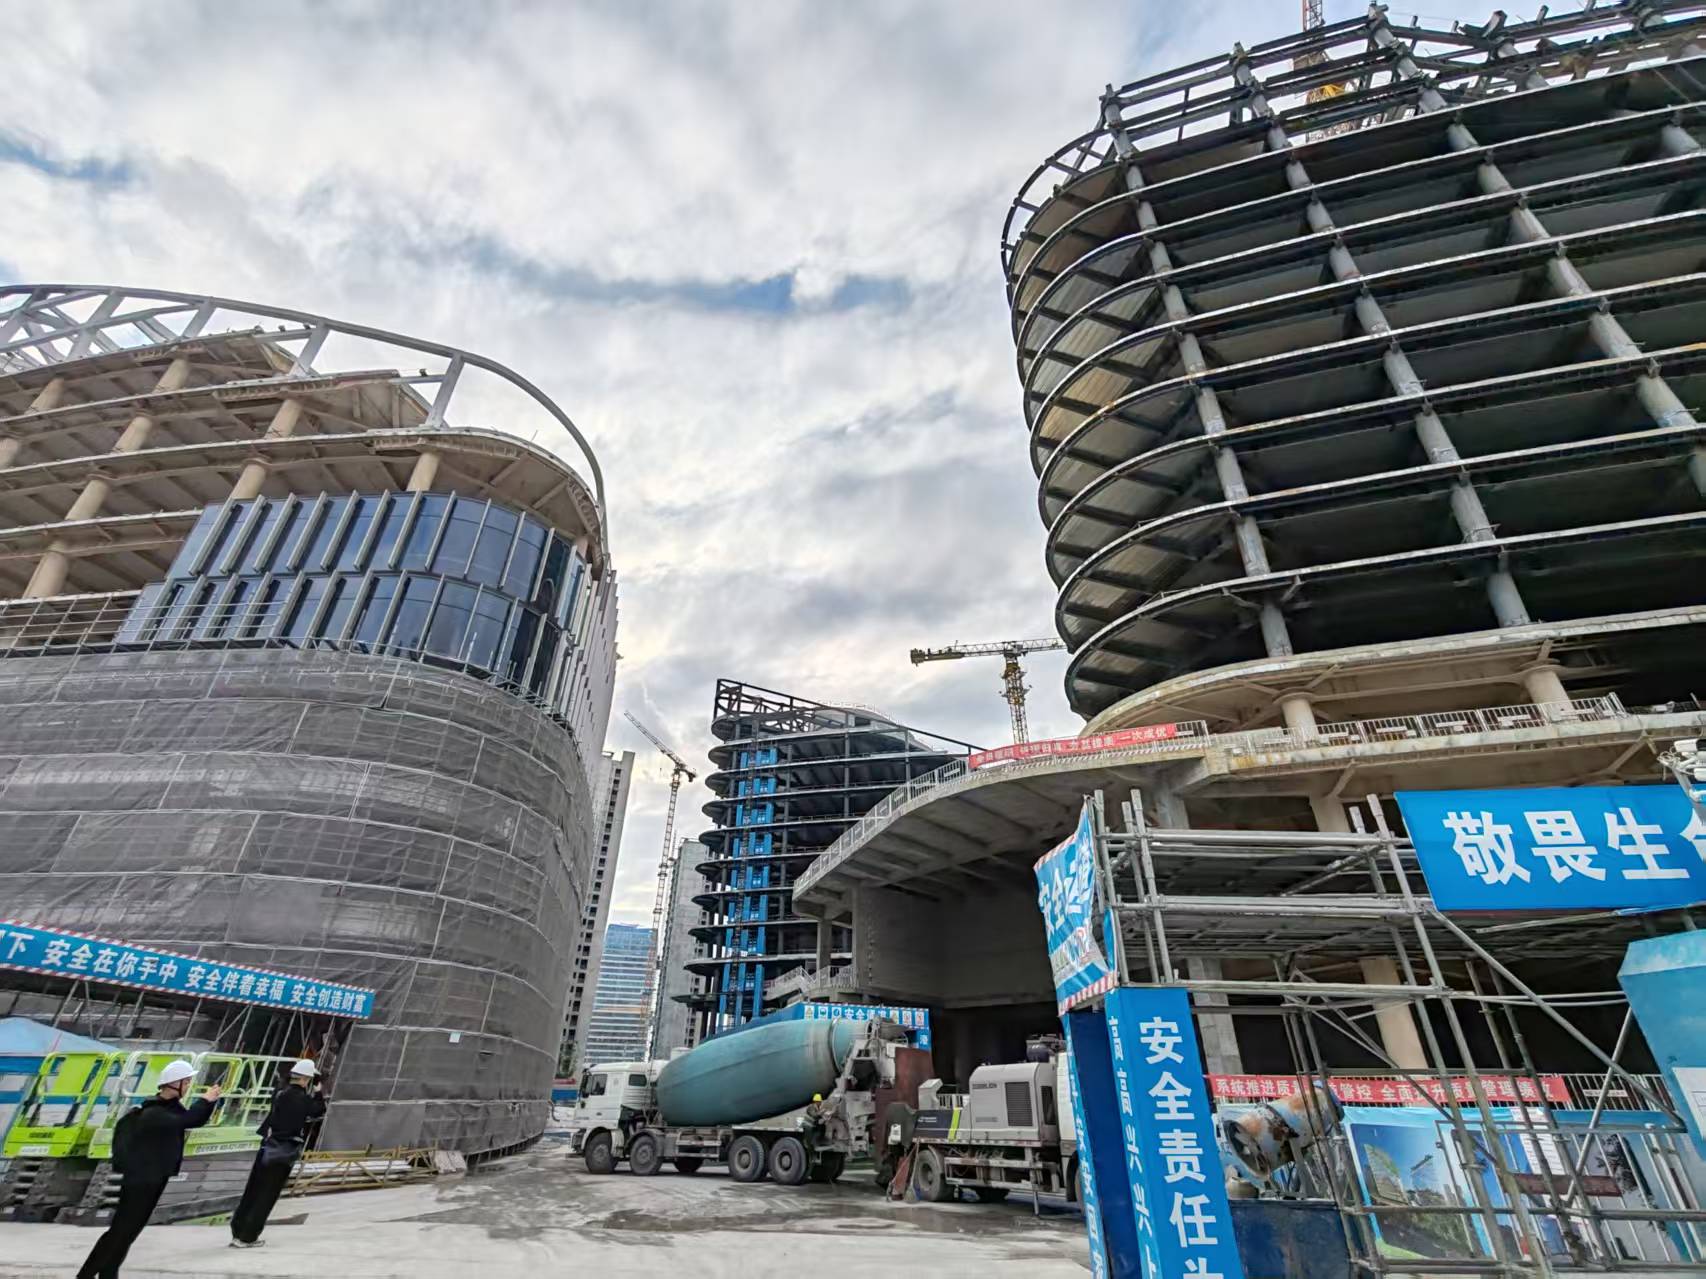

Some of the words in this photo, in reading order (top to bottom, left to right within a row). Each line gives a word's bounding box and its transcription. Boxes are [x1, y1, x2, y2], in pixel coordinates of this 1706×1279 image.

[0, 930, 34, 959] 下
[42, 939, 178, 984] 安全在你手中
[184, 965, 286, 1001] 安全伴着幸福
[290, 983, 367, 1013] 安全创造财富
